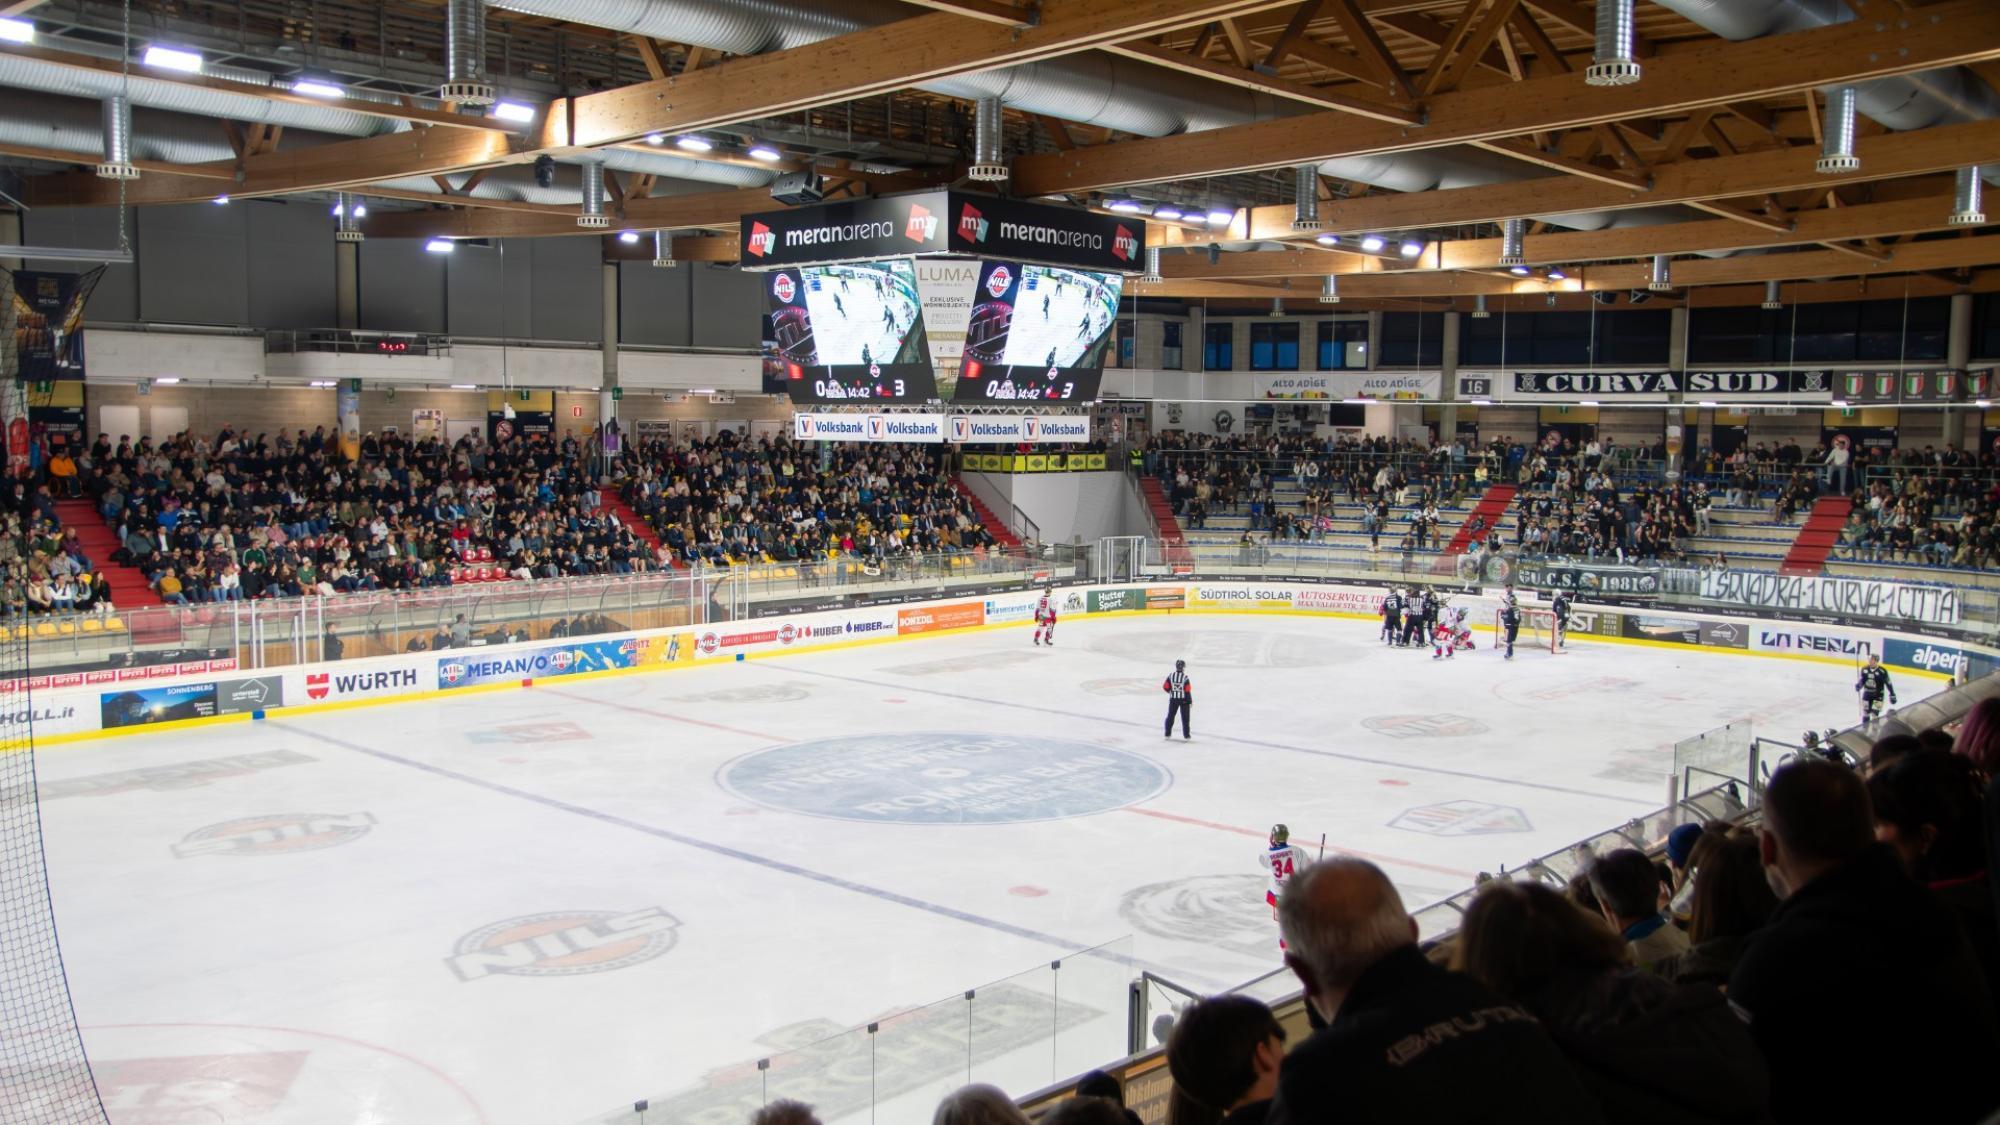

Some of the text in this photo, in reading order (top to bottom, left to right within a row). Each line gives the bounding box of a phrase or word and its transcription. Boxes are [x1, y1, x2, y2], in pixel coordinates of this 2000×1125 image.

[786, 221, 893, 247] meranarena
[1001, 222, 1102, 249] meranarena
[920, 267, 975, 281] LUMA
[815, 380, 826, 397] 0
[894, 379, 905, 397] 3
[986, 380, 998, 397] 0
[1467, 380, 1484, 394] 16
[1546, 373, 1778, 392] CURVA SUD
[848, 387, 870, 398] 14:42
[1017, 388, 1041, 400] 14:42
[1061, 382, 1074, 399] 3
[815, 421, 863, 434] Volksbank
[886, 422, 938, 435] Volksbank
[971, 423, 1019, 435] Volksbank
[1040, 423, 1086, 435] Volksbank
[1602, 575, 1638, 592] 1981
[1098, 590, 1126, 602] Hutter
[1201, 586, 1293, 600] SÜDTIROL SOLAR
[1297, 591, 1368, 603] AUTOSERVICE
[1099, 599, 1122, 611] Sport
[813, 625, 843, 638] HUBER
[853, 621, 882, 633] HUBER
[777, 629, 799, 640] NILS
[699, 638, 720, 649] NILS
[468, 655, 548, 678] MERAN/O
[167, 683, 214, 695] SONNENBERG
[1272, 857, 1295, 879] 34
[444, 908, 684, 982] NILS
